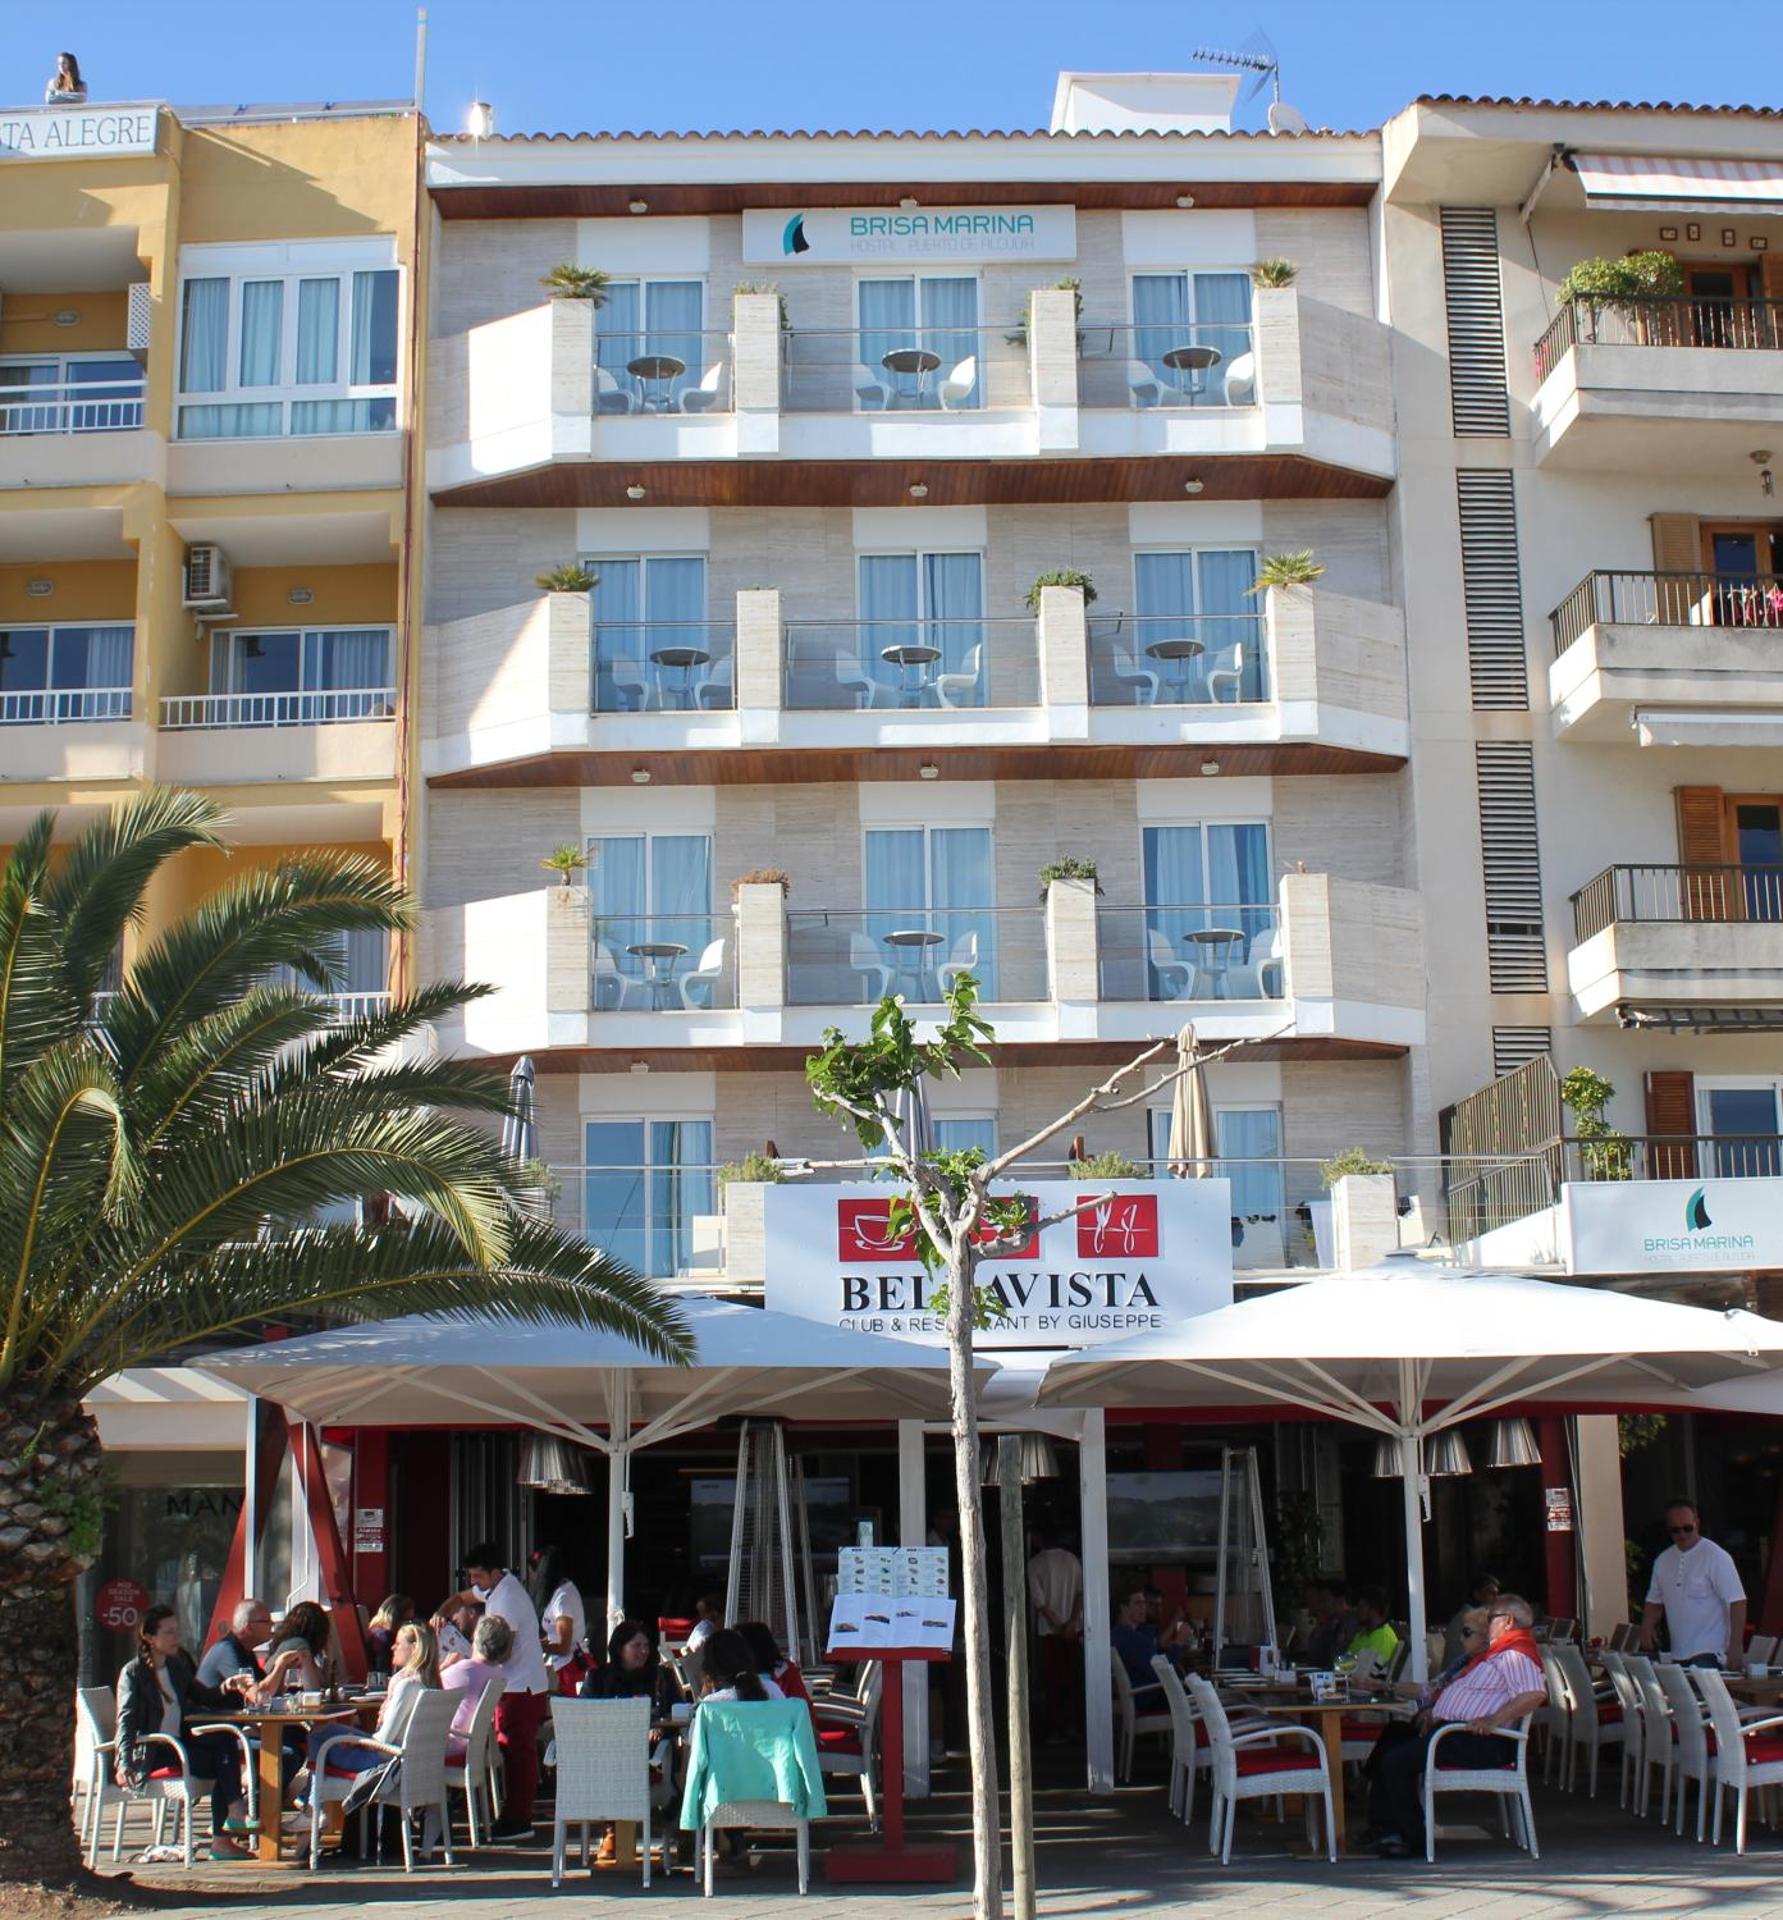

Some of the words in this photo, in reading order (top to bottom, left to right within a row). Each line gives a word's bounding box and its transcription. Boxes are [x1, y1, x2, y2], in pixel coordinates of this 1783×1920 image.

[44, 116, 150, 148] ALEGRE
[850, 216, 929, 236] BRISA
[934, 214, 1034, 235] MARINA
[1644, 1237, 1691, 1252] BRISA
[1695, 1235, 1754, 1249] MARINA
[841, 1272, 1161, 1311] BELAVISTA
[891, 1318, 905, 1332] &
[909, 1315, 1030, 1332] RESANT
[1038, 1315, 1061, 1330] BY
[1068, 1314, 1161, 1329] GIUSEPPE
